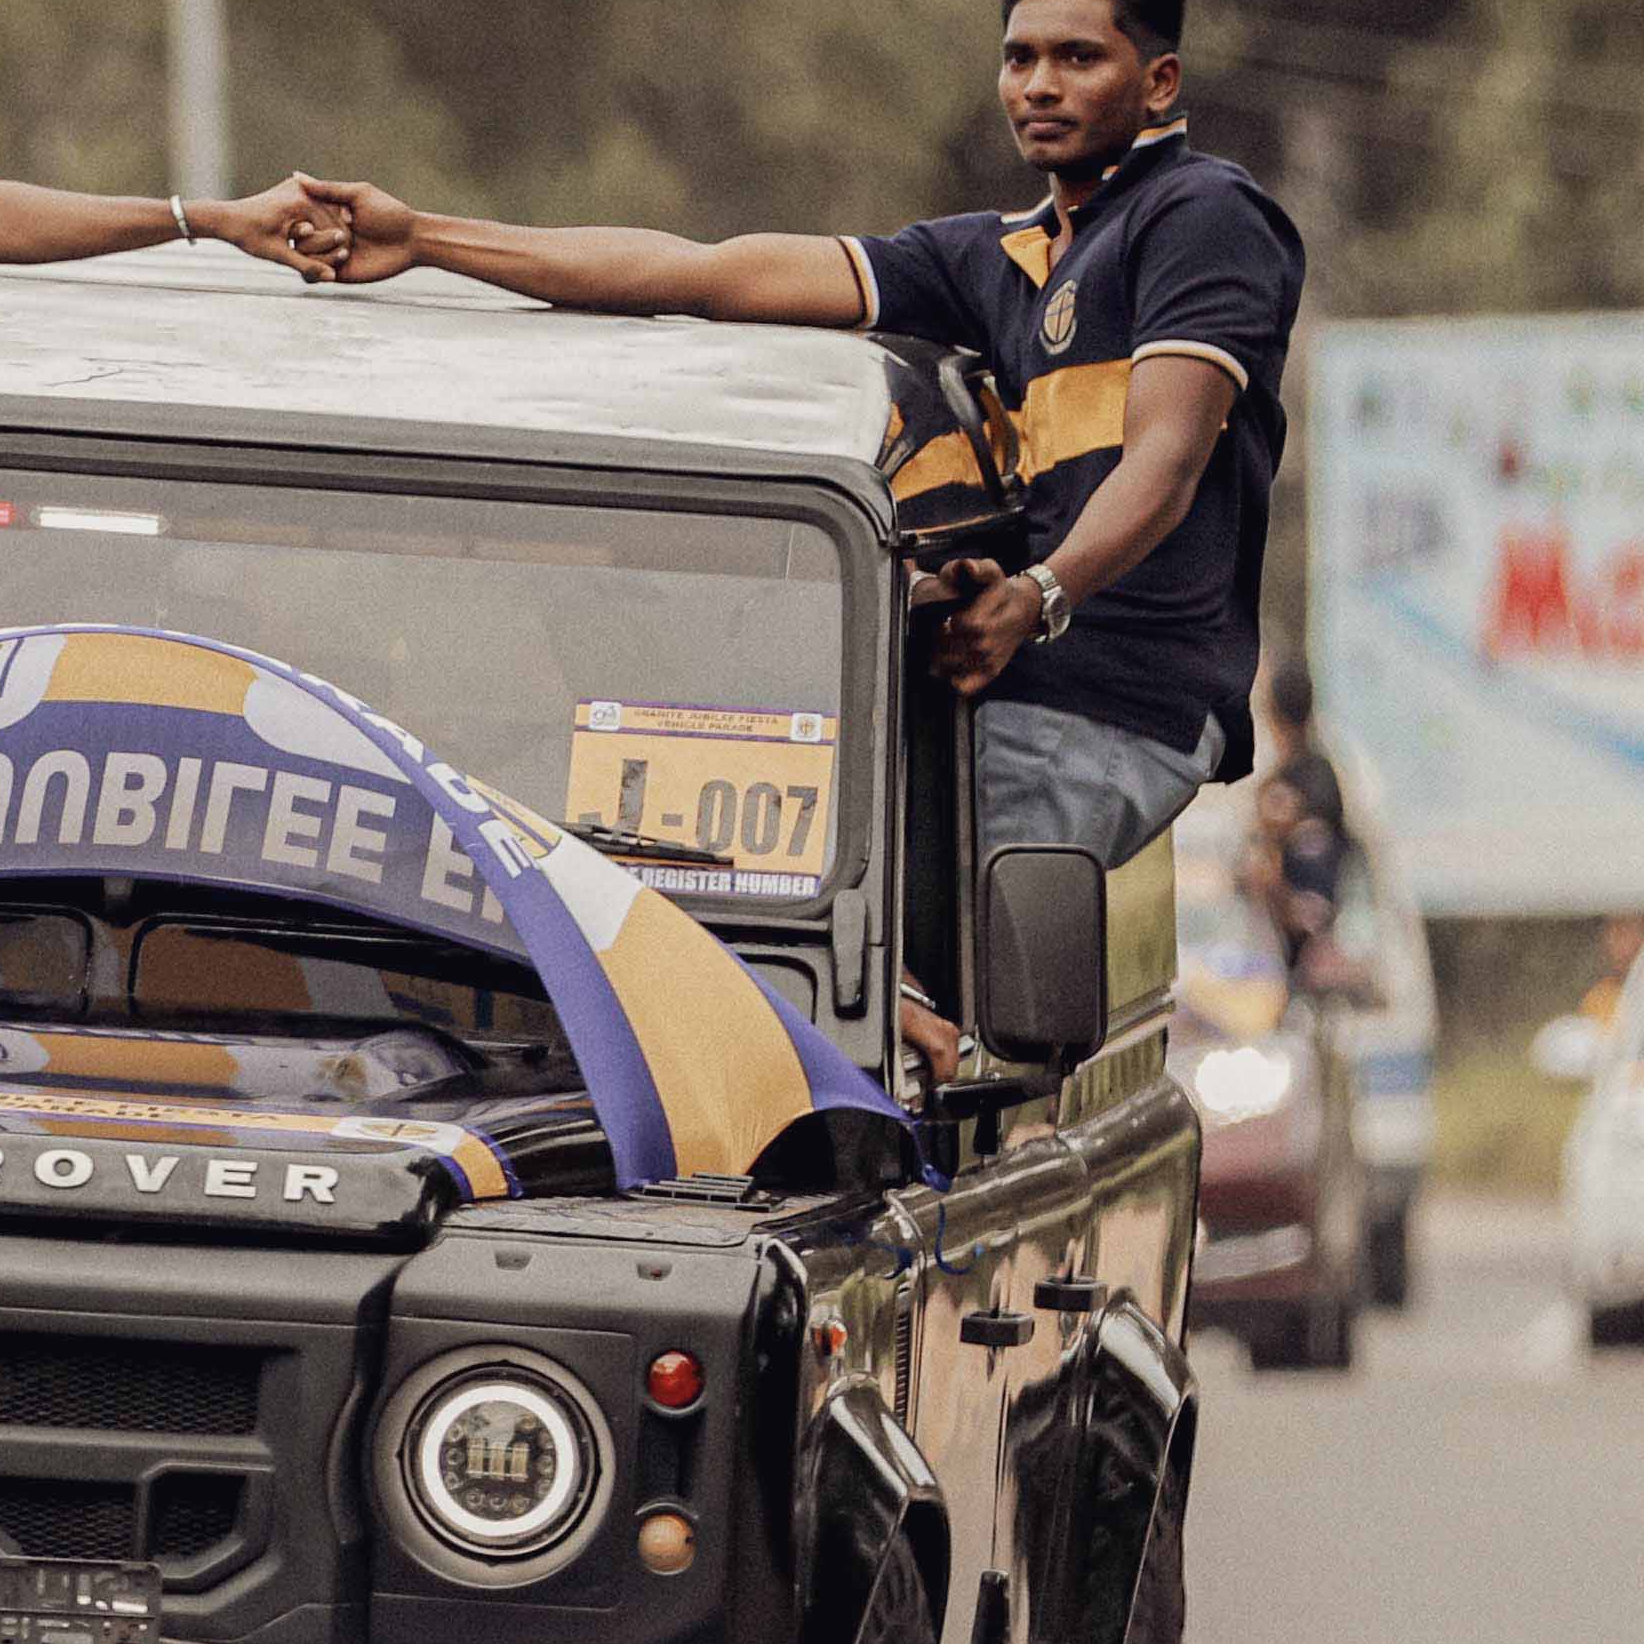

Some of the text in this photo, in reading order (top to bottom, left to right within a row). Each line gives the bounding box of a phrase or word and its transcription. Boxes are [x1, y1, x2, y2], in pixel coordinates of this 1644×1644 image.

[738, 715, 779, 725] FIESTA
[708, 723, 754, 733] PARADE
[641, 867, 732, 891] REGISTER
[735, 871, 816, 896] NUMBER
